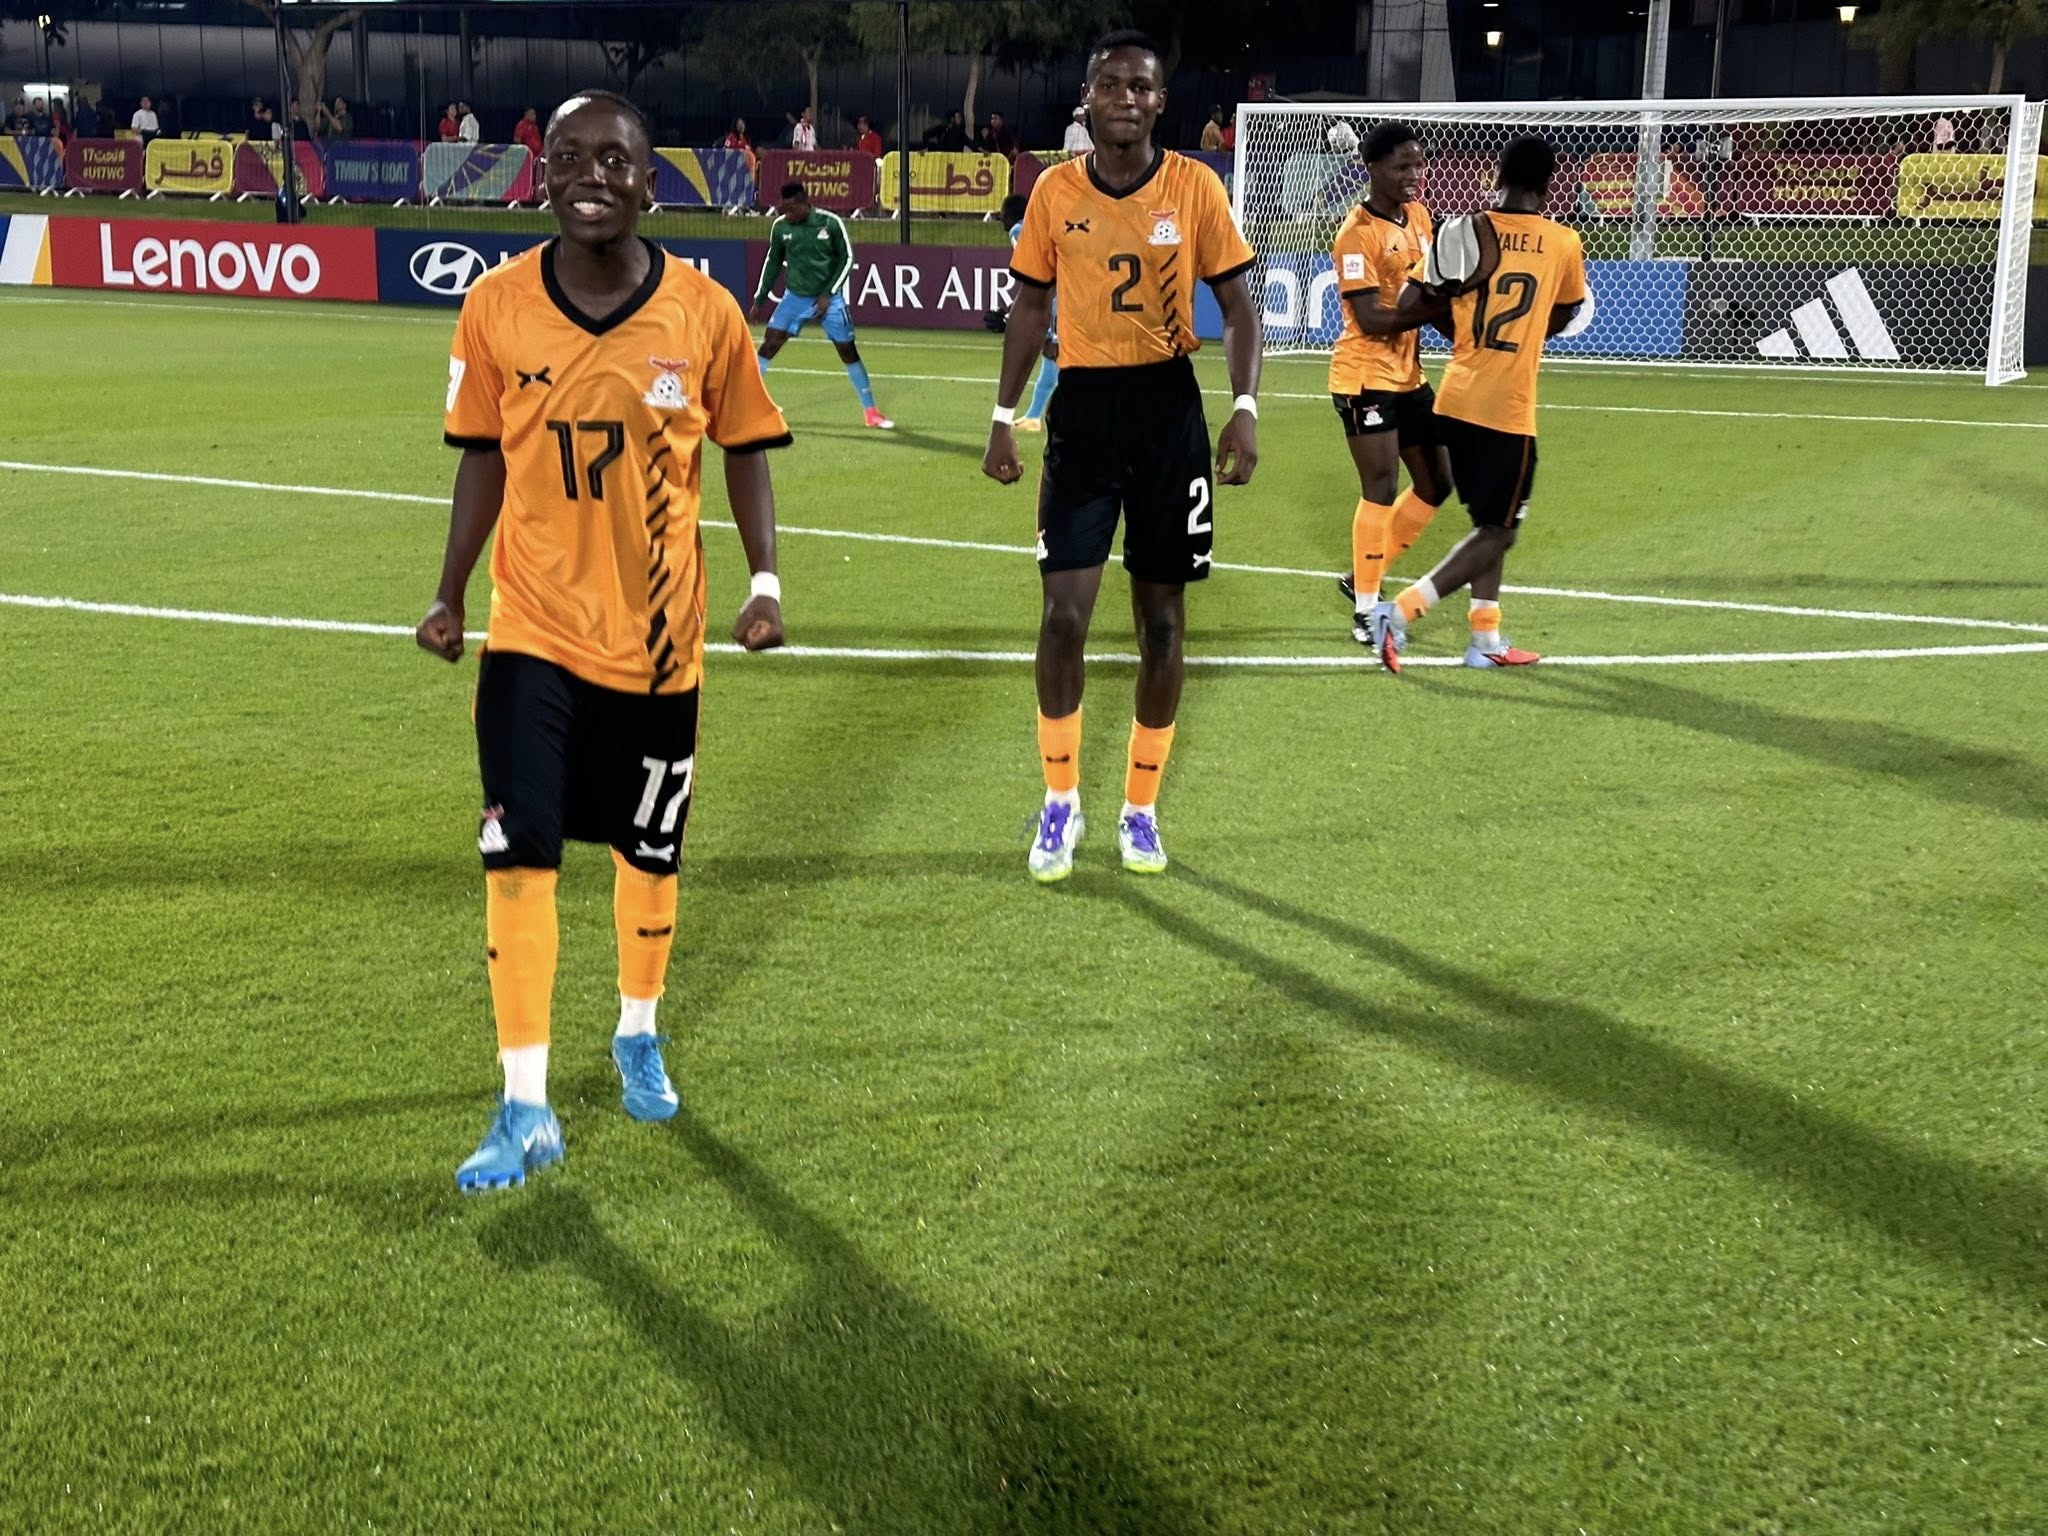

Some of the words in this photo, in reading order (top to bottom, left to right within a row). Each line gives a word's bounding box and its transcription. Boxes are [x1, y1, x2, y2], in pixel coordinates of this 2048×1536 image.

[83, 165, 125, 180] #U17WC
[155, 147, 224, 185] قطر
[803, 181, 849, 198] 17WC
[893, 160, 994, 204] قط
[100, 222, 321, 295] Lenovo
[1107, 252, 1144, 313] 2
[1472, 271, 1539, 354] 12
[545, 420, 625, 502] 17
[1187, 476, 1212, 536] 2
[633, 754, 694, 834] 17
